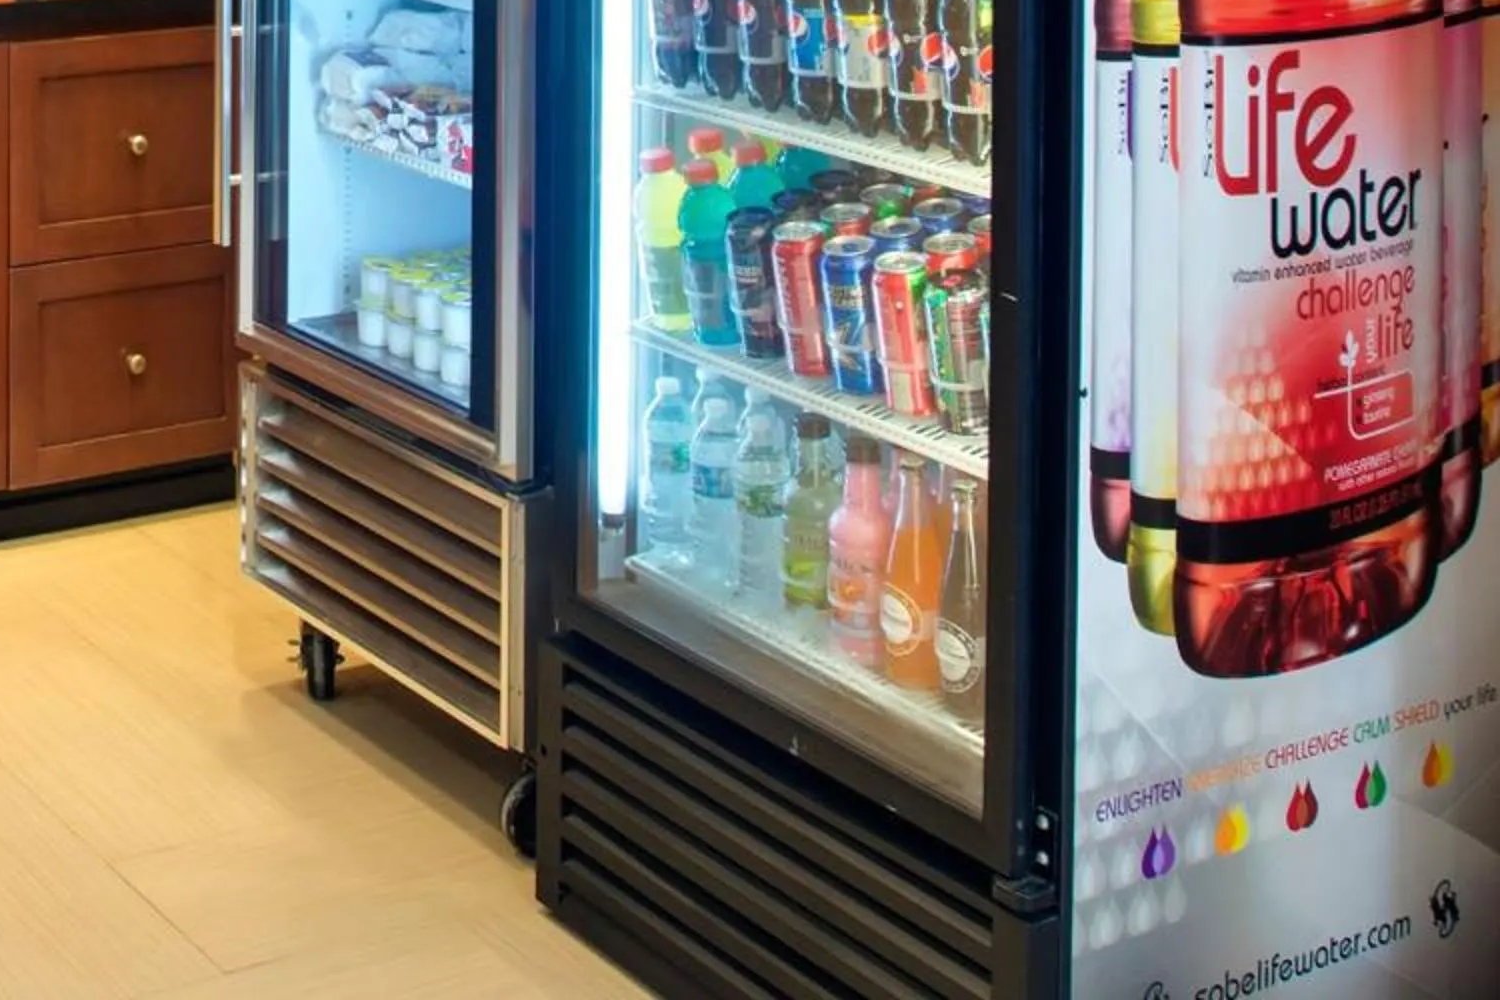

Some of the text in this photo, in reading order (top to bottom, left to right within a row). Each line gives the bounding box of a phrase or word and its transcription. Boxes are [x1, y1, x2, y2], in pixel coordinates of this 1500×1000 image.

[1270, 168, 1422, 259] water
[1274, 260, 1332, 280] enhanced
[1297, 264, 1415, 320] challenge
[1378, 309, 1415, 359] life
[1095, 776, 1183, 823] ENLIGHTEN
[1265, 727, 1349, 770] CHALLENGE
[1353, 713, 1391, 743] CALM
[1394, 700, 1440, 732] SHIELD
[1443, 695, 1474, 722] your
[1194, 914, 1412, 1000] sobelifewater.com
